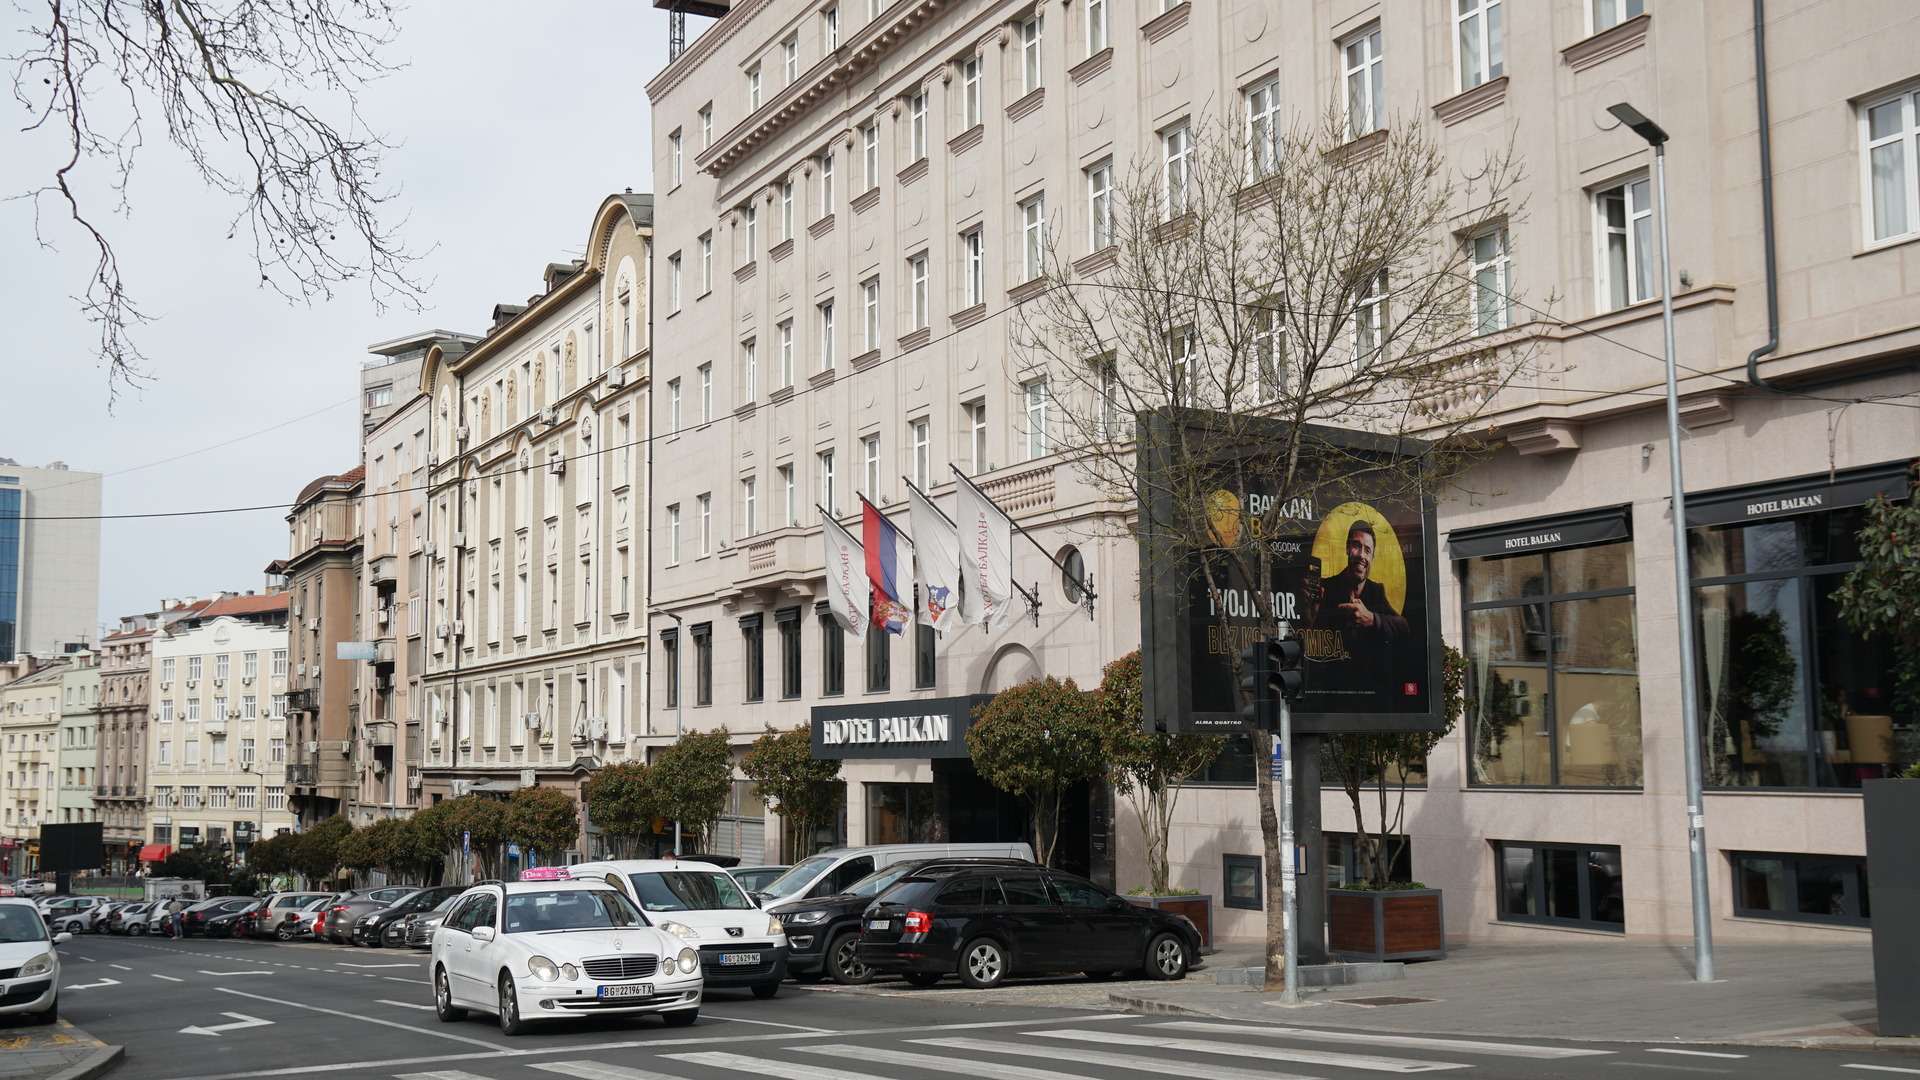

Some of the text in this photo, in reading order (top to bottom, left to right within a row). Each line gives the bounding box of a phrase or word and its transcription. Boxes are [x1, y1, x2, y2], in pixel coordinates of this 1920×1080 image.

[1747, 495, 1822, 515] HOTEL BALKAN
[978, 520, 988, 570] БАЛКАН
[1270, 541, 1302, 553] OGODAK
[1505, 533, 1561, 549] HOTEL BALKAN
[840, 553, 850, 596] БАЛКАН
[823, 715, 949, 745] HOTEL BALKAN
[604, 987, 615, 997] BG
